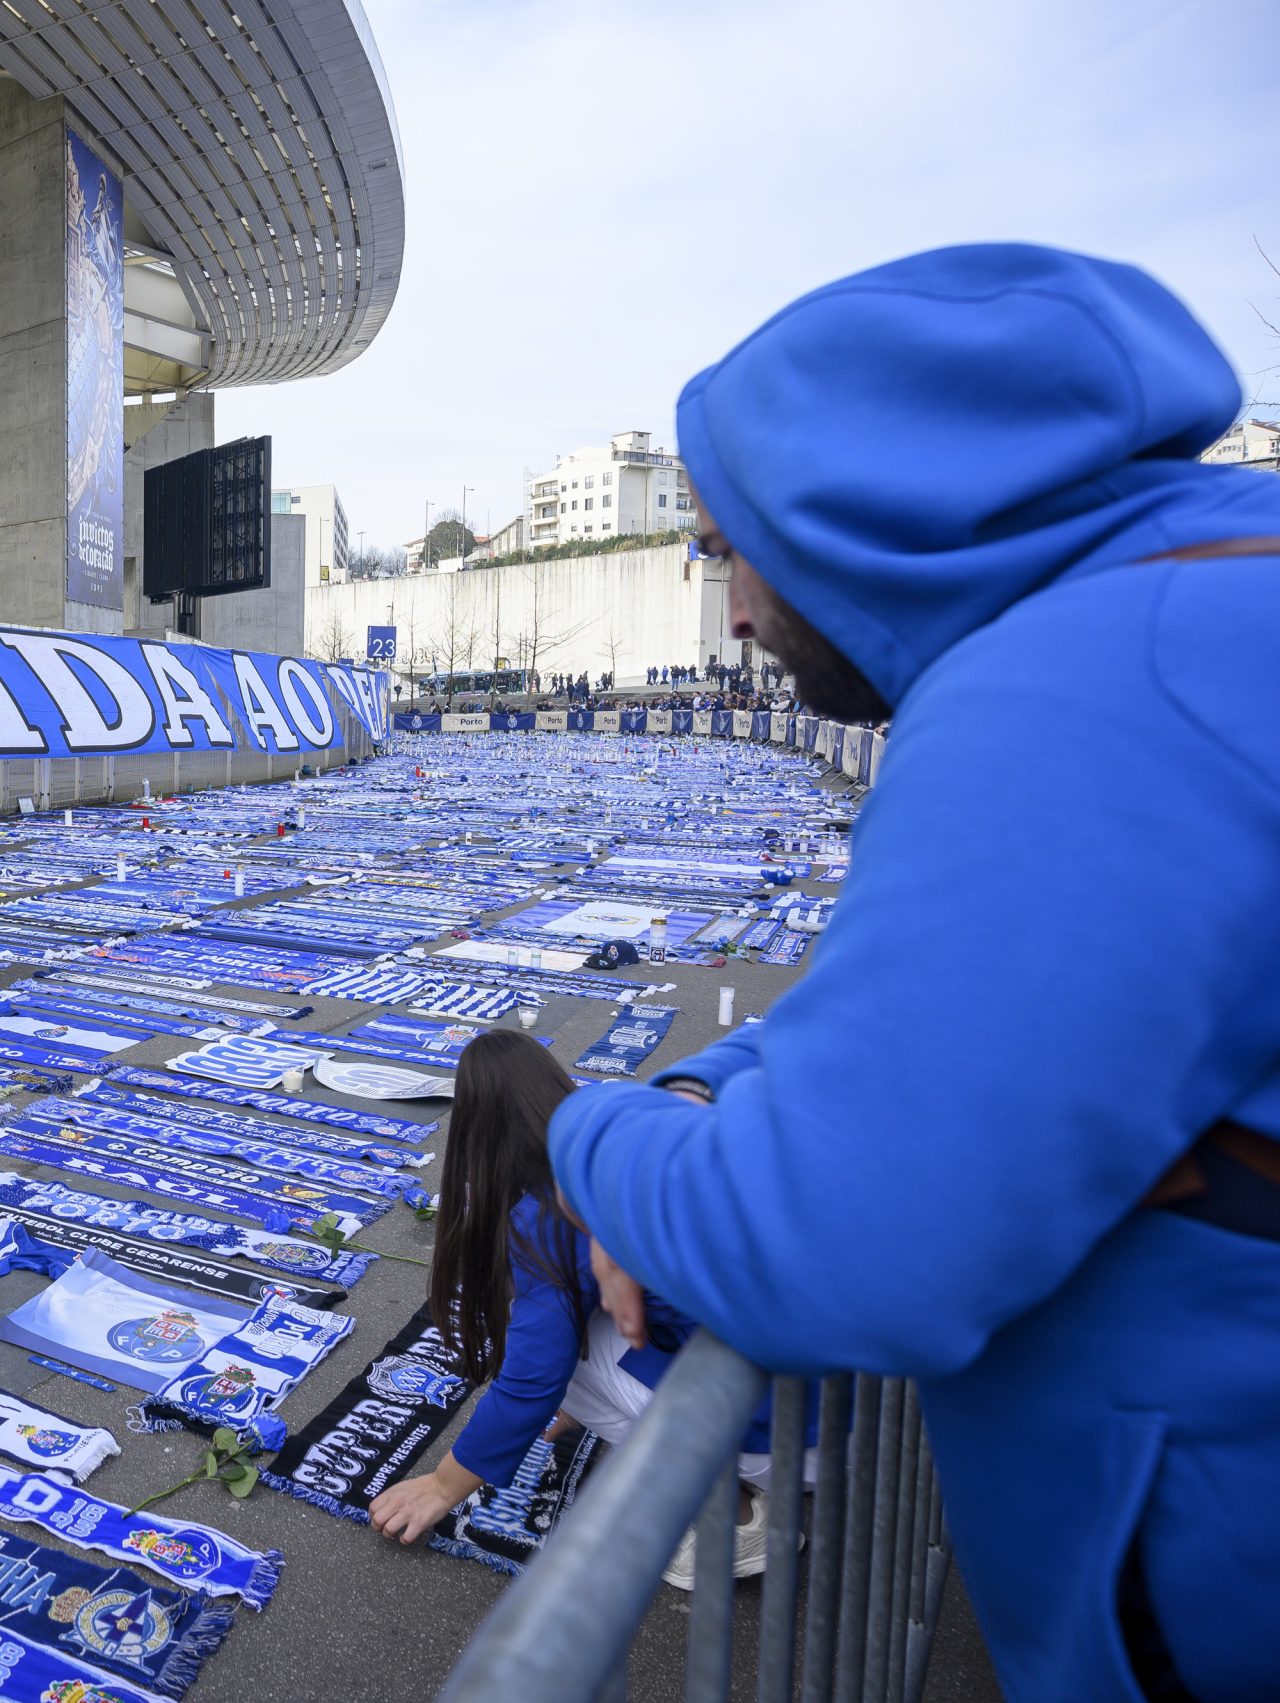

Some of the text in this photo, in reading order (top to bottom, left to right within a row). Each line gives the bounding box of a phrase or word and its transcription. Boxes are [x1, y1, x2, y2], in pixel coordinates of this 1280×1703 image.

[372, 638, 395, 658] 23
[231, 650, 333, 752] AO
[460, 718, 483, 726] Porto
[547, 716, 563, 724] Porto
[603, 716, 616, 725] Porto
[234, 1092, 360, 1122] PORTO
[126, 1117, 190, 1137] Porto
[84, 1154, 110, 1165] FUTEBOL
[109, 1161, 130, 1170] CLUBE
[139, 1169, 162, 1178] PORTO
[131, 1148, 261, 1184] Campeão
[269, 1149, 341, 1171] Porto
[63, 1157, 240, 1209] RAUL
[165, 1174, 192, 1186] FUTEBOL
[192, 1182, 214, 1192] CLUBE
[224, 1191, 249, 1200] PORTO
[19, 1194, 187, 1241] PORTO
[22, 1182, 230, 1236] FUTEBOL CLUBE
[203, 1202, 229, 1211] PORTO
[252, 1198, 282, 1210] FUTEBOL
[283, 1205, 307, 1215] CLUBE
[70, 1230, 125, 1251] CLUBE
[125, 1246, 229, 1280] CESARENSE
[397, 1366, 428, 1392] XXV
[292, 1398, 417, 1498] SUPER
[363, 1464, 399, 1498] SEMPRE
[390, 1422, 433, 1472] PRESENTES
[67, 1497, 109, 1523] 18
[49, 1510, 99, 1538] 93
